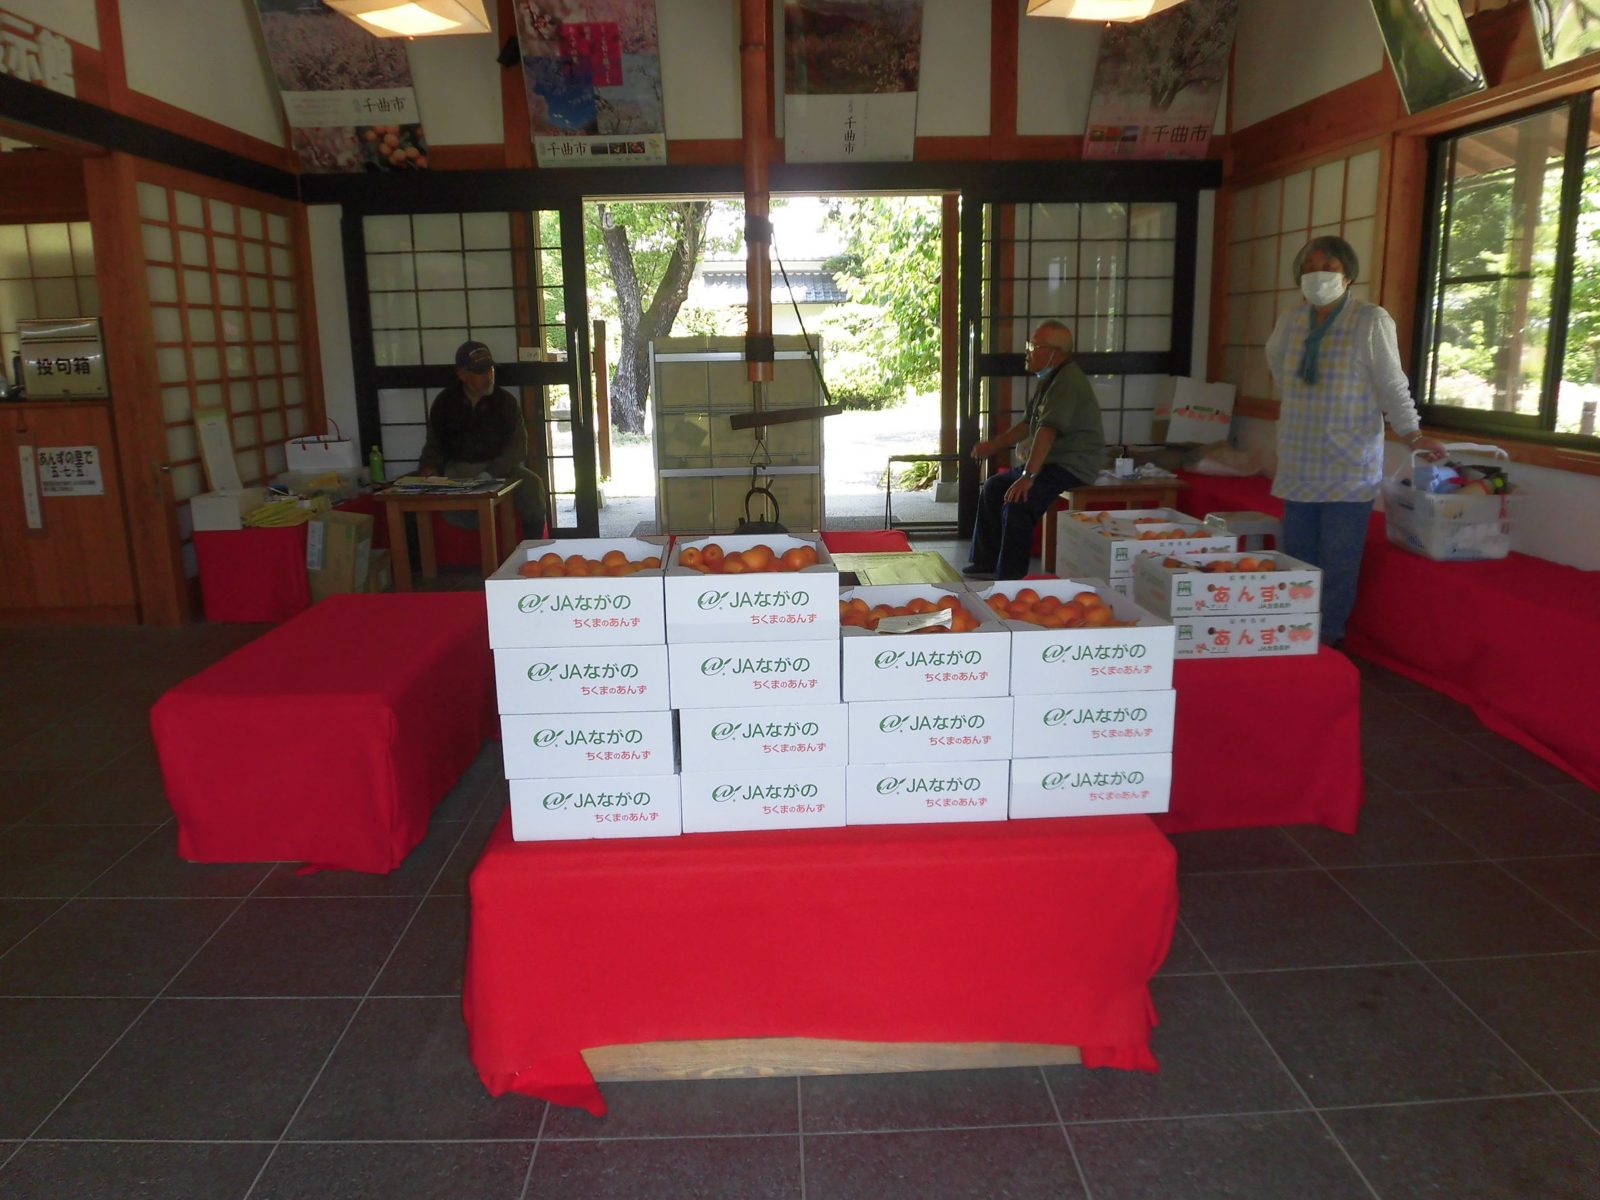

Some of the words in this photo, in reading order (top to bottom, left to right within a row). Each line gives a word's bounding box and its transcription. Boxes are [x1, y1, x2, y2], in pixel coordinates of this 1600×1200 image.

[363, 96, 405, 112] 千曲市
[844, 115, 856, 155] 千曲市
[1152, 124, 1209, 143] 千曲市
[547, 141, 588, 157] 千曲市
[36, 357, 91, 376] 投句箱
[39, 450, 94, 466] あんずの里で
[729, 590, 810, 608] JAながの
[1213, 585, 1280, 603] あんず
[550, 594, 631, 612] JAながの
[573, 616, 640, 628] ちくまのあんず
[750, 613, 817, 625] ちくまのあんず
[1213, 628, 1280, 646] あんず
[905, 649, 982, 667] JAながの
[1071, 643, 1146, 661] JAながの
[559, 663, 639, 680] JAながの
[732, 657, 811, 674] JAながの
[1090, 664, 1152, 676] ちくまのあんず
[753, 678, 818, 690] ちくまのあんず
[924, 671, 988, 682] ちくまのあんず
[580, 684, 647, 695] ちくまのあんず
[909, 714, 985, 731] JAながの
[1073, 707, 1148, 724] JAながの
[564, 729, 643, 746] JAながの
[742, 722, 819, 739] JAながの
[1090, 727, 1153, 738] ちくまのあんず
[762, 742, 827, 754] ちくまのあんず
[928, 735, 992, 746] ちくまのあんず
[585, 750, 651, 761] ちくまのあんず
[906, 776, 981, 793] JAながの
[1071, 771, 1145, 788] JAながの
[573, 791, 651, 809] JAながの
[742, 783, 818, 801] JAながの
[1089, 790, 1150, 801] ちくまのあんず
[762, 803, 826, 814] ちくまのあんず
[925, 797, 988, 808] ちくまのあんず
[595, 811, 659, 823] ちくまのあんず
